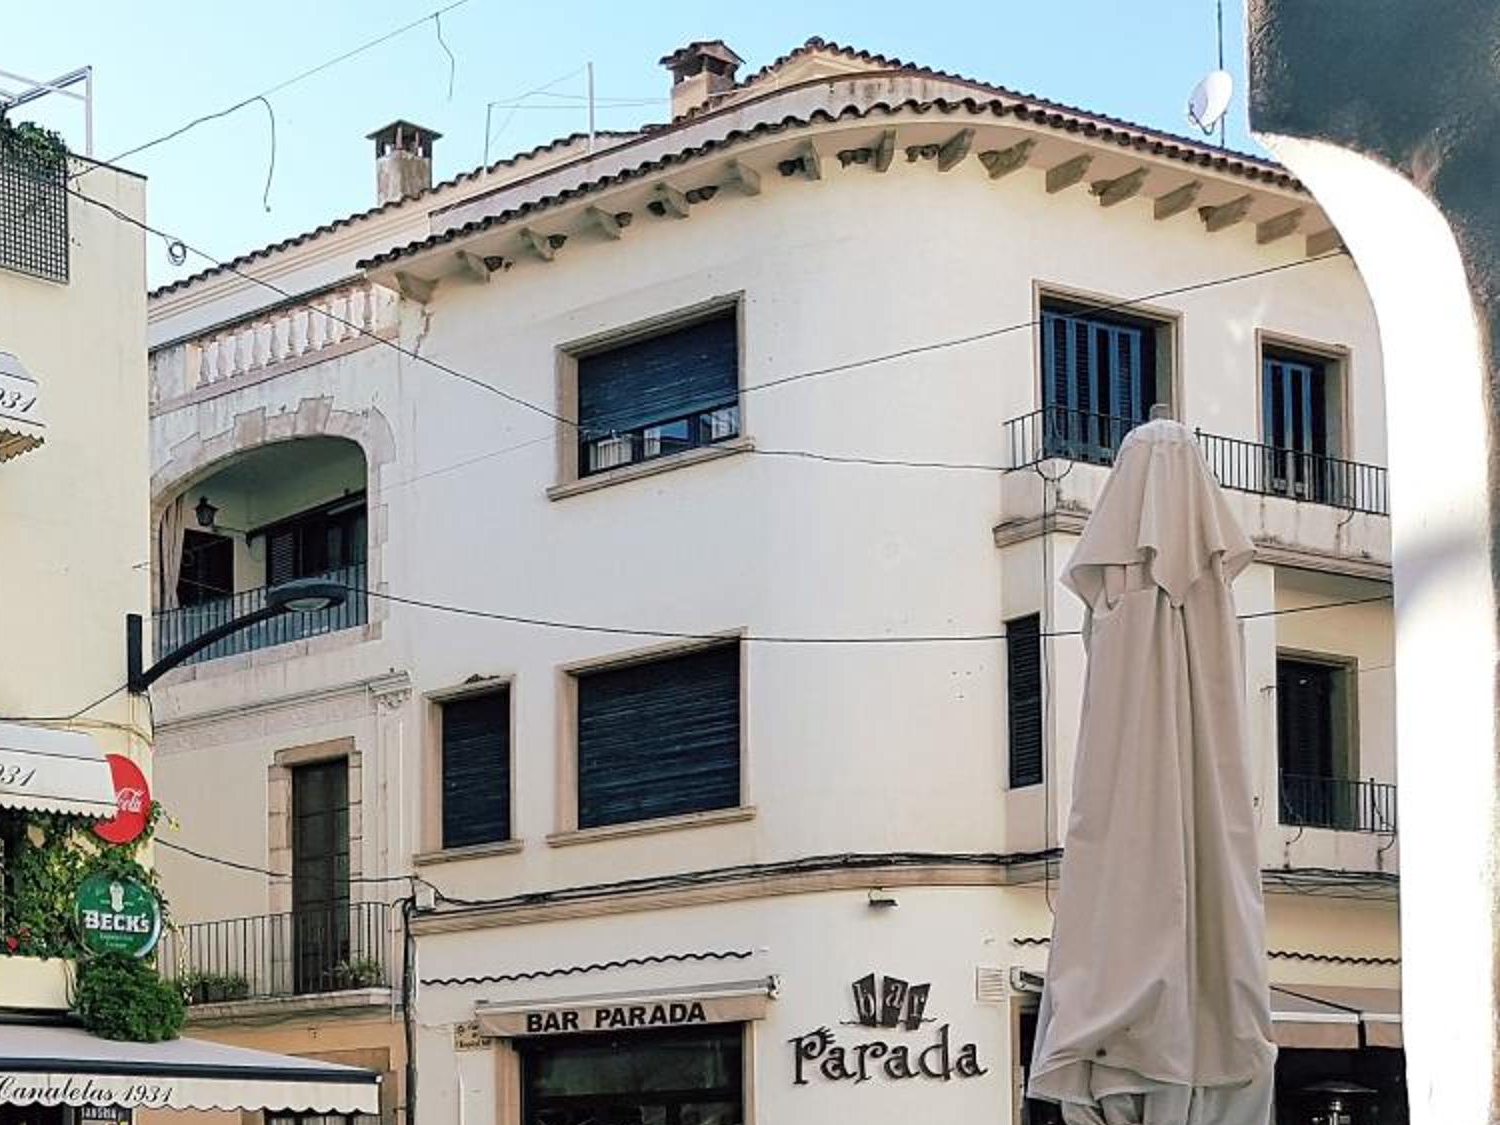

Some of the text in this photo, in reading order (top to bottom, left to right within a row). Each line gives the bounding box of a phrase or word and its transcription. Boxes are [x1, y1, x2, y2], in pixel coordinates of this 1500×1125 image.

[526, 1002, 707, 1033] BAR PARADA
[852, 980, 927, 1020] bar
[788, 1023, 989, 1085] Parada
[123, 1084, 173, 1102] 1931
